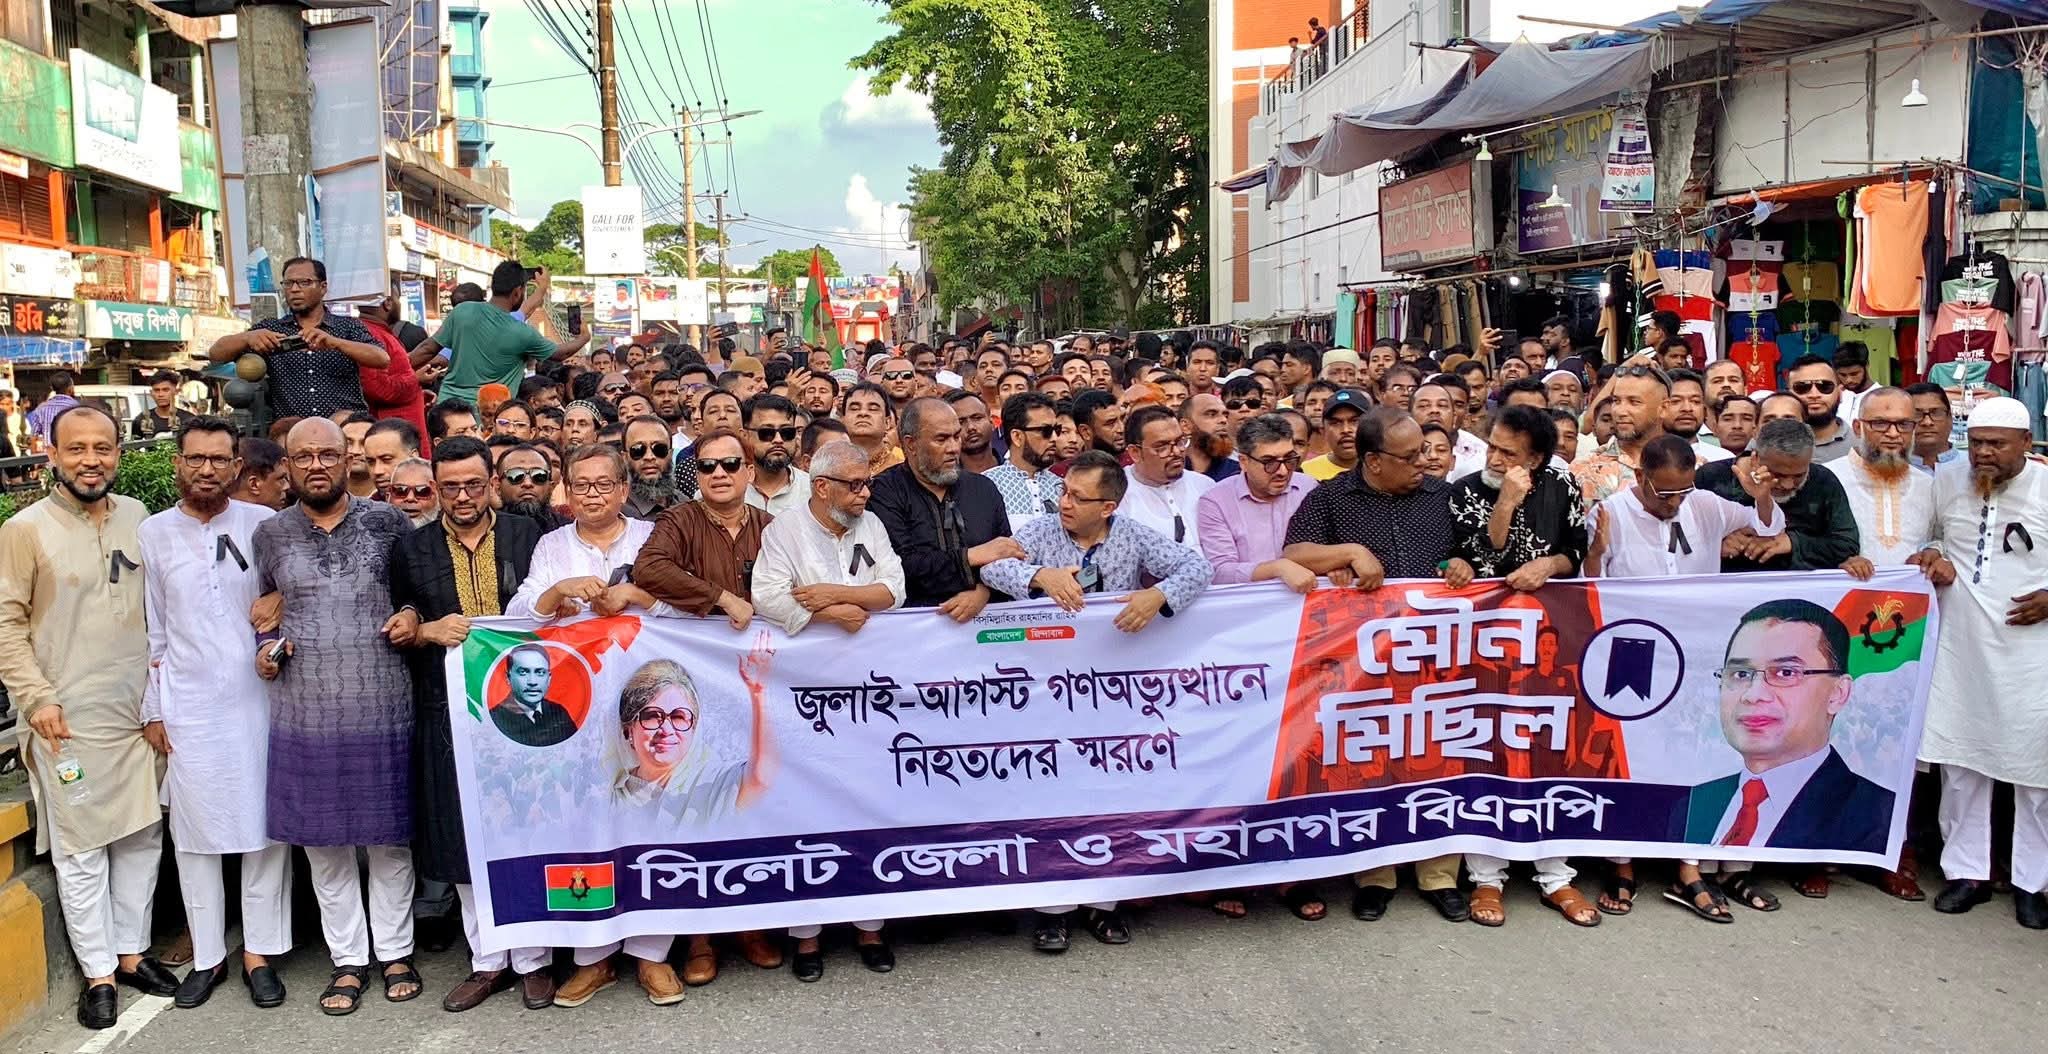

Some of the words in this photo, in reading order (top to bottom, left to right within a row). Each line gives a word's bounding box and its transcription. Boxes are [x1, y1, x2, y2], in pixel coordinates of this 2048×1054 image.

[592, 214, 612, 225] CALL
[616, 214, 635, 225] FOR
[111, 308, 144, 336] সবুজ
[986, 630, 1023, 641] বাংলাদেশ
[1030, 628, 1064, 639] জিন্দাবাদ
[1356, 590, 1544, 675] মৌন
[790, 663, 1036, 736] জুলাই-আগস্ট
[1048, 661, 1271, 721] গণঅভ্যুত্থানে
[1314, 678, 1575, 766] মিছিল
[887, 732, 1061, 787] নিহতদের
[1068, 726, 1182, 773] স্মরণে
[627, 840, 853, 900] সিলেট
[872, 833, 1039, 885] জেলা
[1058, 833, 1114, 867] ও
[1131, 806, 1388, 864] মহানগর
[1396, 784, 1616, 835] বিএনপি
